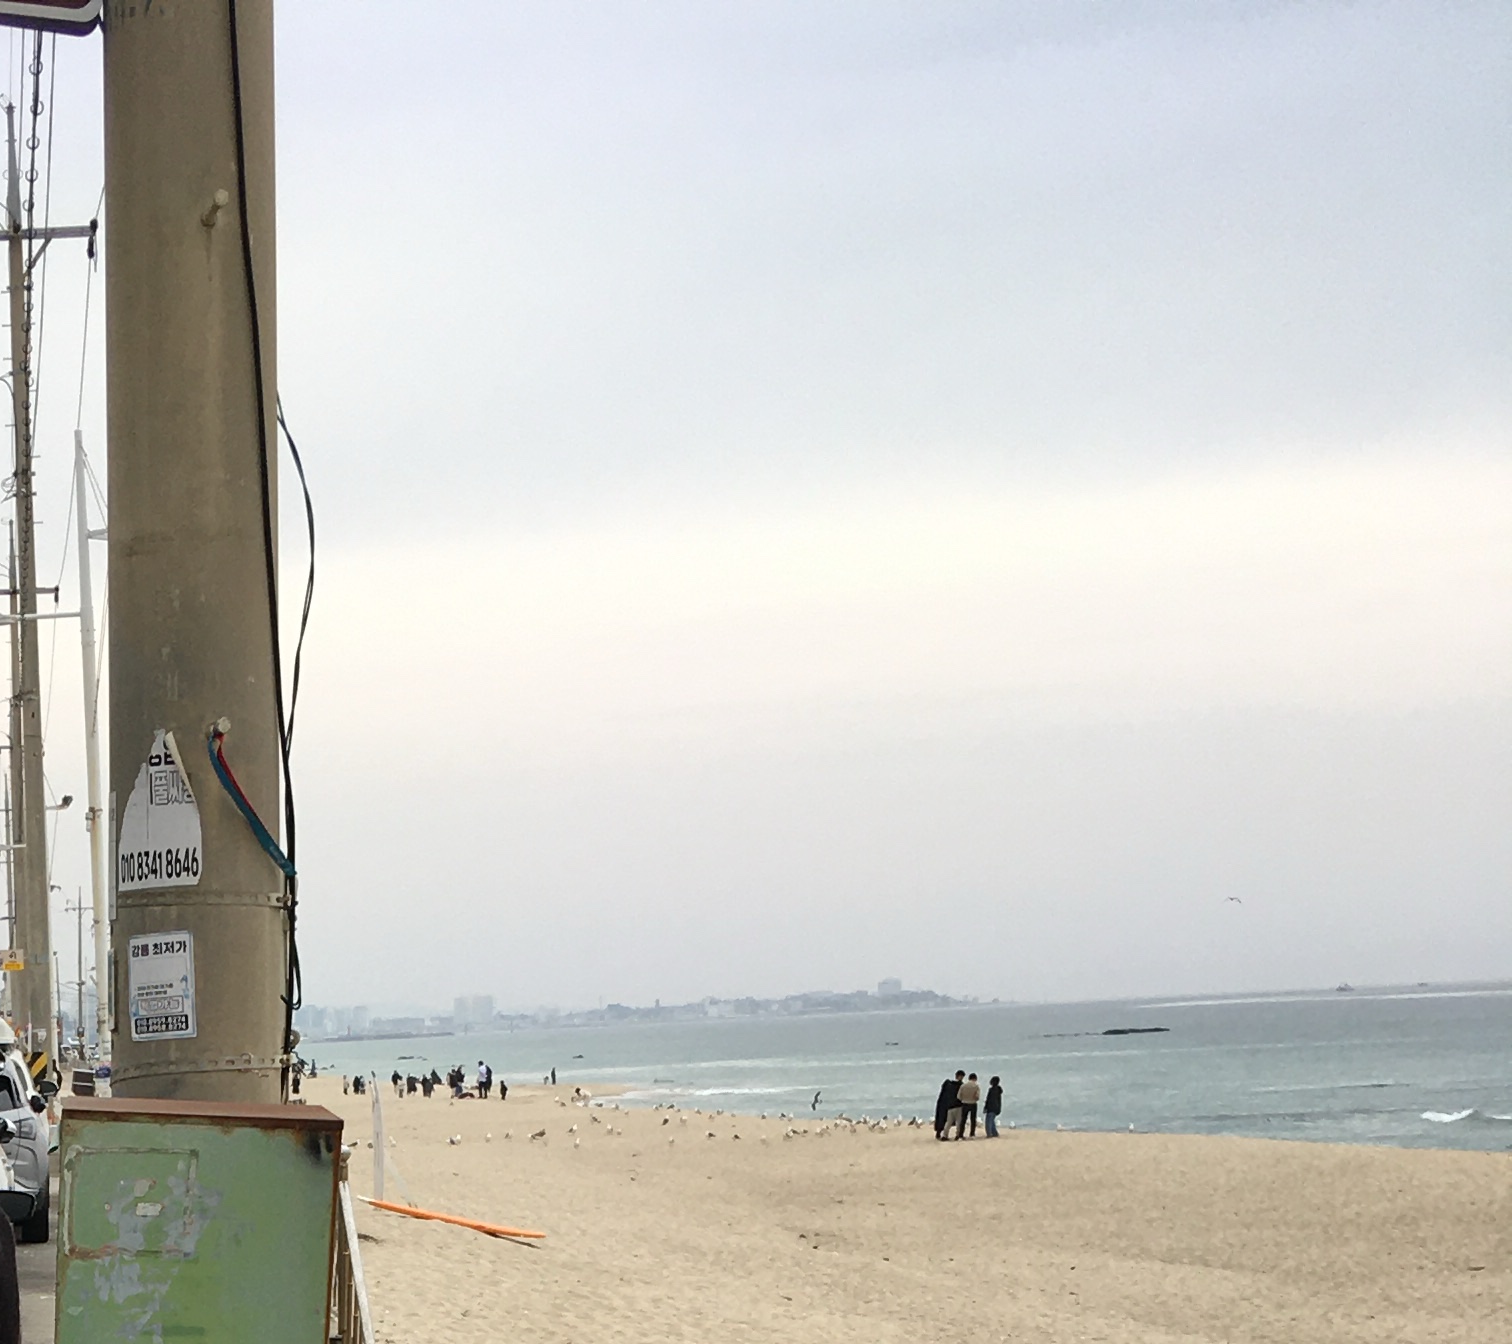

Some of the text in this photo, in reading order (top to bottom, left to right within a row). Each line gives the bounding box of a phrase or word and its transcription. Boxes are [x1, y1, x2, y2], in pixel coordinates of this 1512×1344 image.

[121, 847, 199, 884] 010 8341 8646
[152, 940, 187, 955] 최저가
